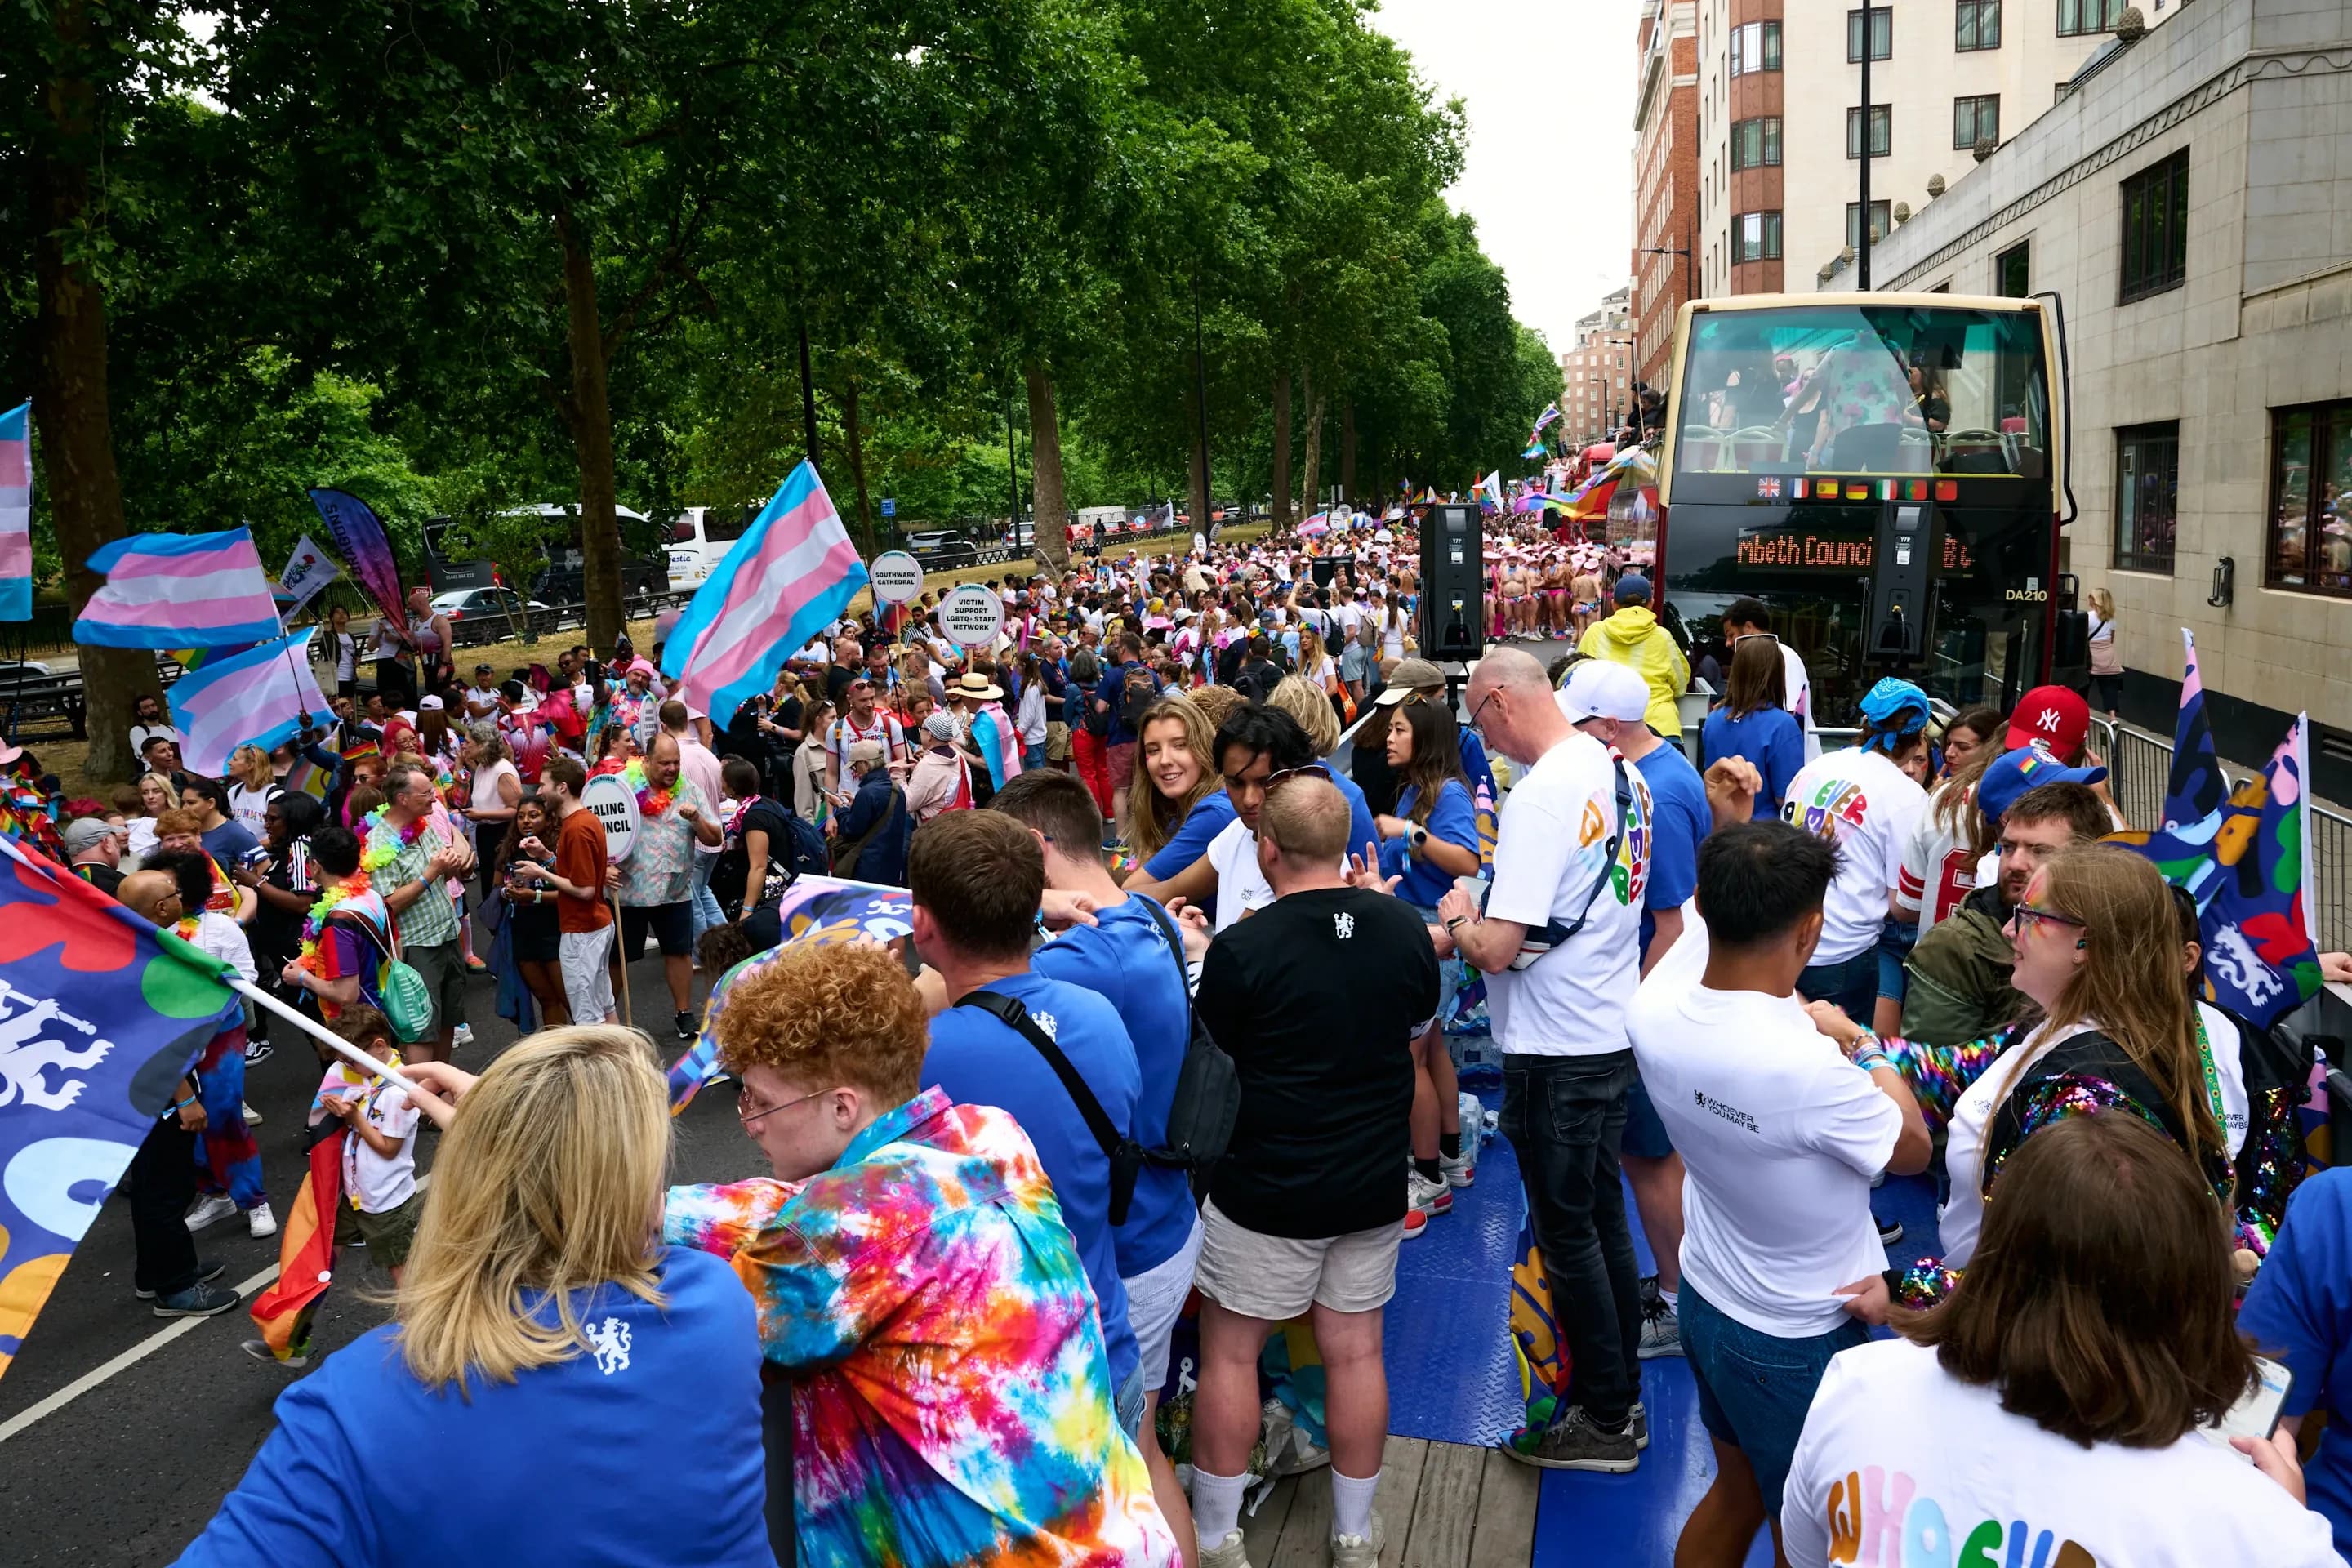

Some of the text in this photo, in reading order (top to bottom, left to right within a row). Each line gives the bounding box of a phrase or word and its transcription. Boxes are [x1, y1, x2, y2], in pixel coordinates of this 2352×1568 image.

[1805, 535, 1873, 567] Counci
[2006, 590, 2047, 602] DA210
[603, 820, 631, 834] NCIL
[1707, 1096, 1754, 1124] WHOEVER
[2225, 1113, 2245, 1121] EVER
[1707, 1104, 1760, 1134] YOU MAY BE
[2238, 1121, 2248, 1129] BE
